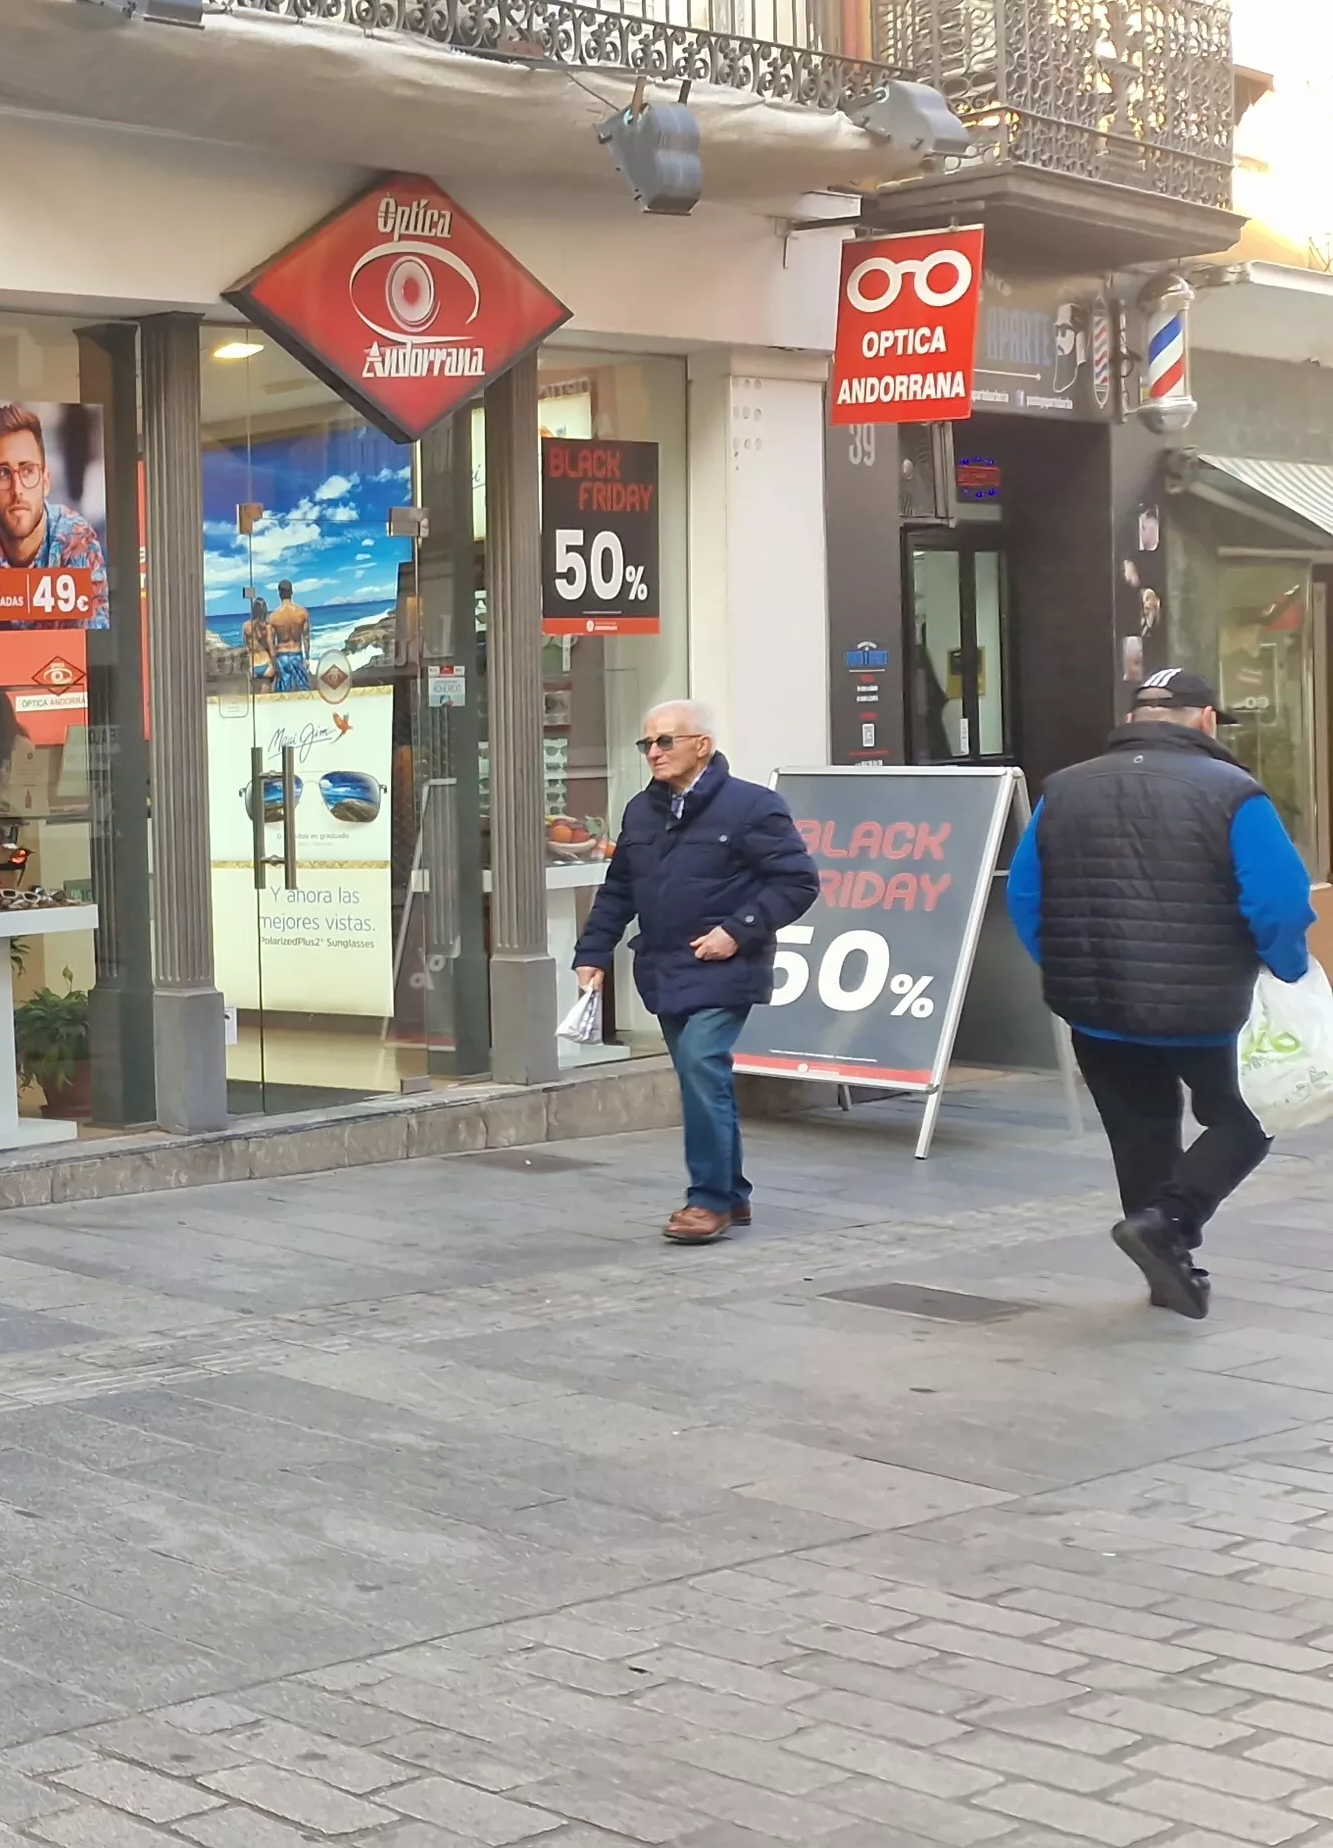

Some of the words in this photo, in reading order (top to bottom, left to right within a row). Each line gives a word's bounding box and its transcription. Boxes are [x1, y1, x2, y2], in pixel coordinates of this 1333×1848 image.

[862, 326, 947, 358] OPTICA
[362, 341, 486, 378] Andorrana
[837, 371, 966, 405] ANDORRANA
[549, 449, 620, 480] BLACK
[578, 481, 654, 512] FRIDAY
[555, 529, 648, 601] 50%
[33, 574, 90, 613] 49€
[270, 885, 282, 903] Y
[286, 886, 332, 904] ahora
[338, 886, 360, 904] las
[815, 870, 951, 912] RIDAY
[259, 912, 320, 933] mejores
[325, 913, 376, 932] vistas.
[326, 938, 376, 949] Sunglasses
